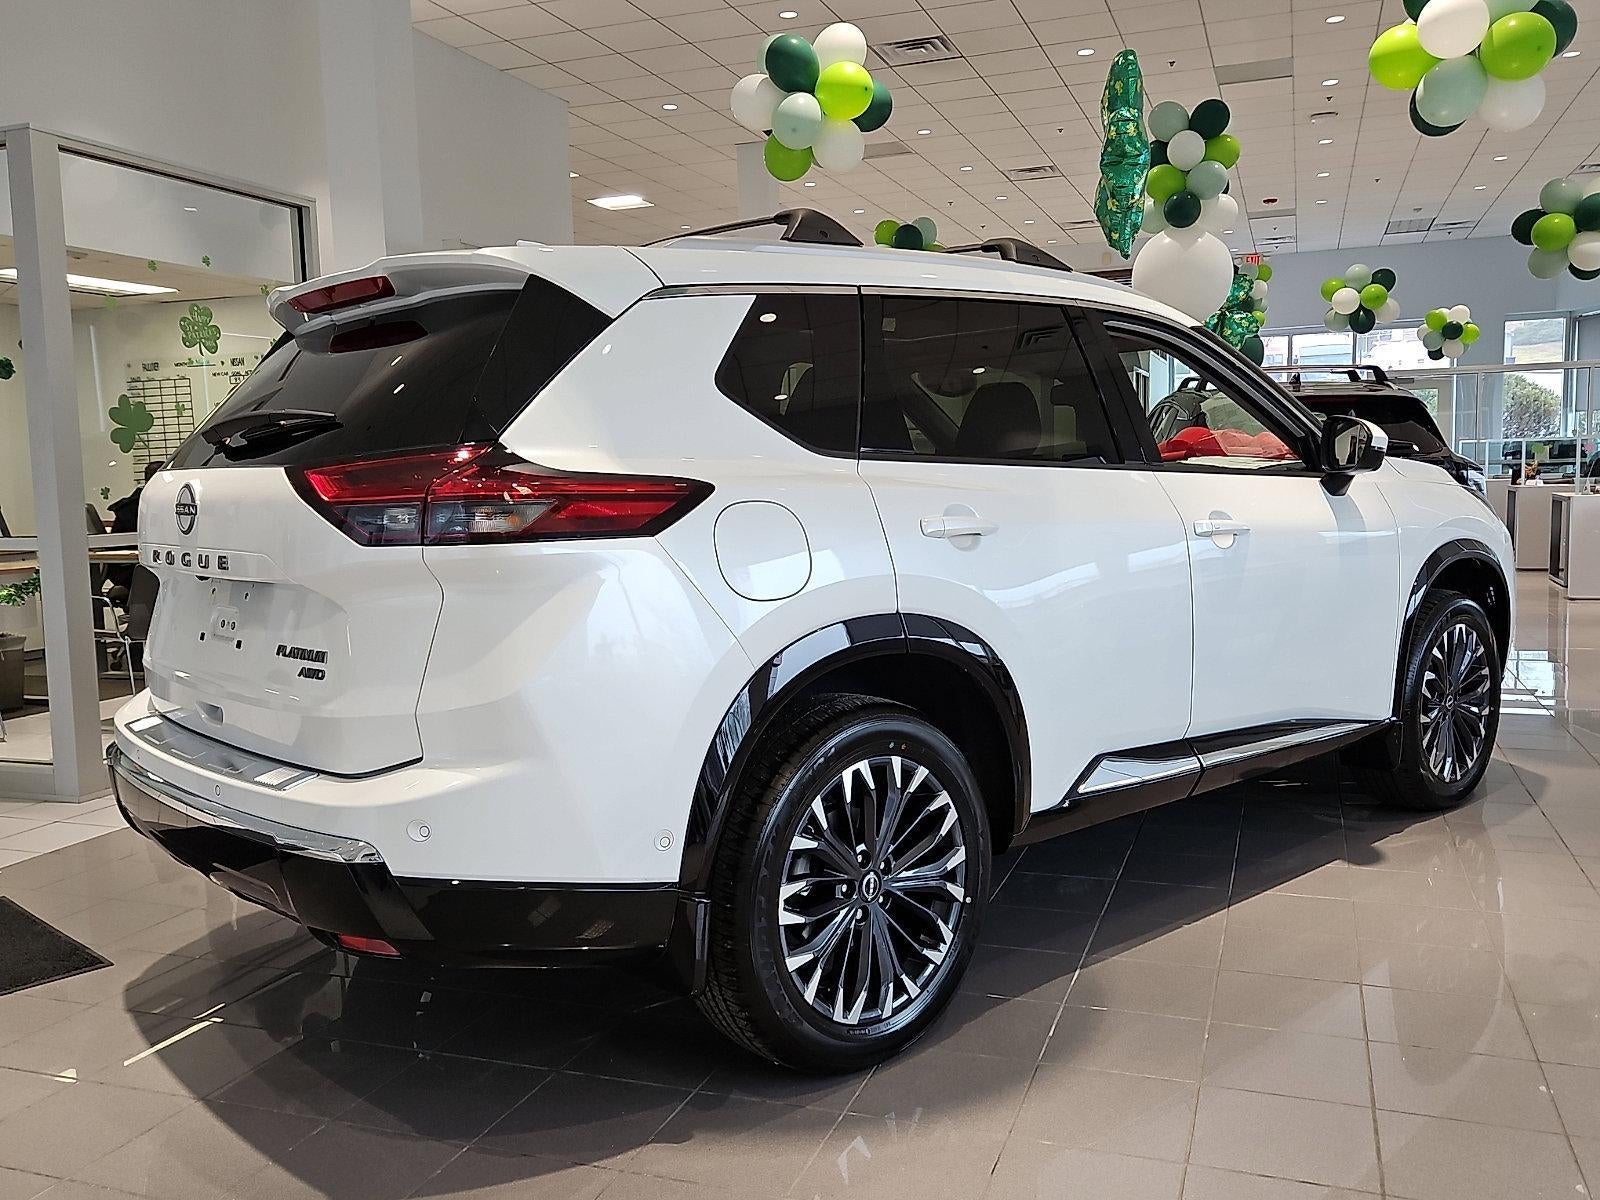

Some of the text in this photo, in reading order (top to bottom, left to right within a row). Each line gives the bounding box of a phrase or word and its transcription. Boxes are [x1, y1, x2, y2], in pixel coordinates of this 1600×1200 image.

[1246, 256, 1260, 265] EXIT
[230, 357, 245, 366] NISSAN
[152, 549, 229, 570] ROGUE
[276, 644, 328, 664] PLATINUM
[297, 667, 325, 680] AWD
